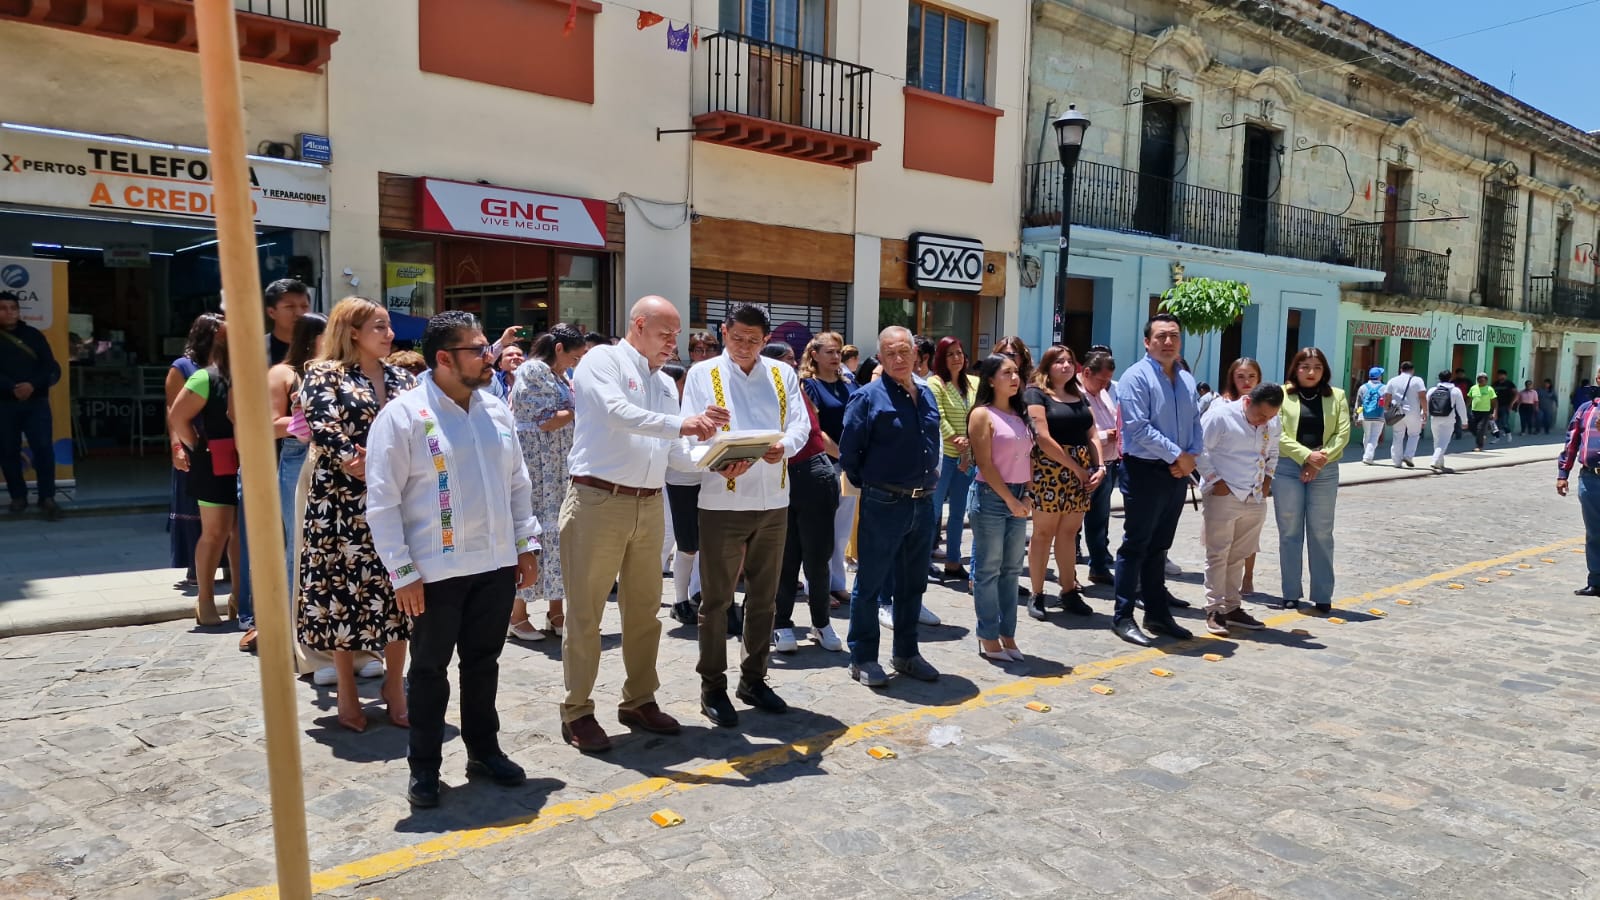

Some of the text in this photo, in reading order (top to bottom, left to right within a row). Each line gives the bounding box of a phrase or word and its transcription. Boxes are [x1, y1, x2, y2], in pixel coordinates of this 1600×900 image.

[88, 148, 260, 187] TELEFOA
[90, 182, 258, 216] A CREDI
[270, 190, 326, 202] REPARACIONES
[481, 198, 559, 223] GNC
[481, 217, 559, 232] VIVE MEJOR
[919, 248, 981, 280] OXXO
[1391, 325, 1431, 338] ESPERANZA
[1456, 323, 1485, 342] Central
[1488, 328, 1495, 343] de
